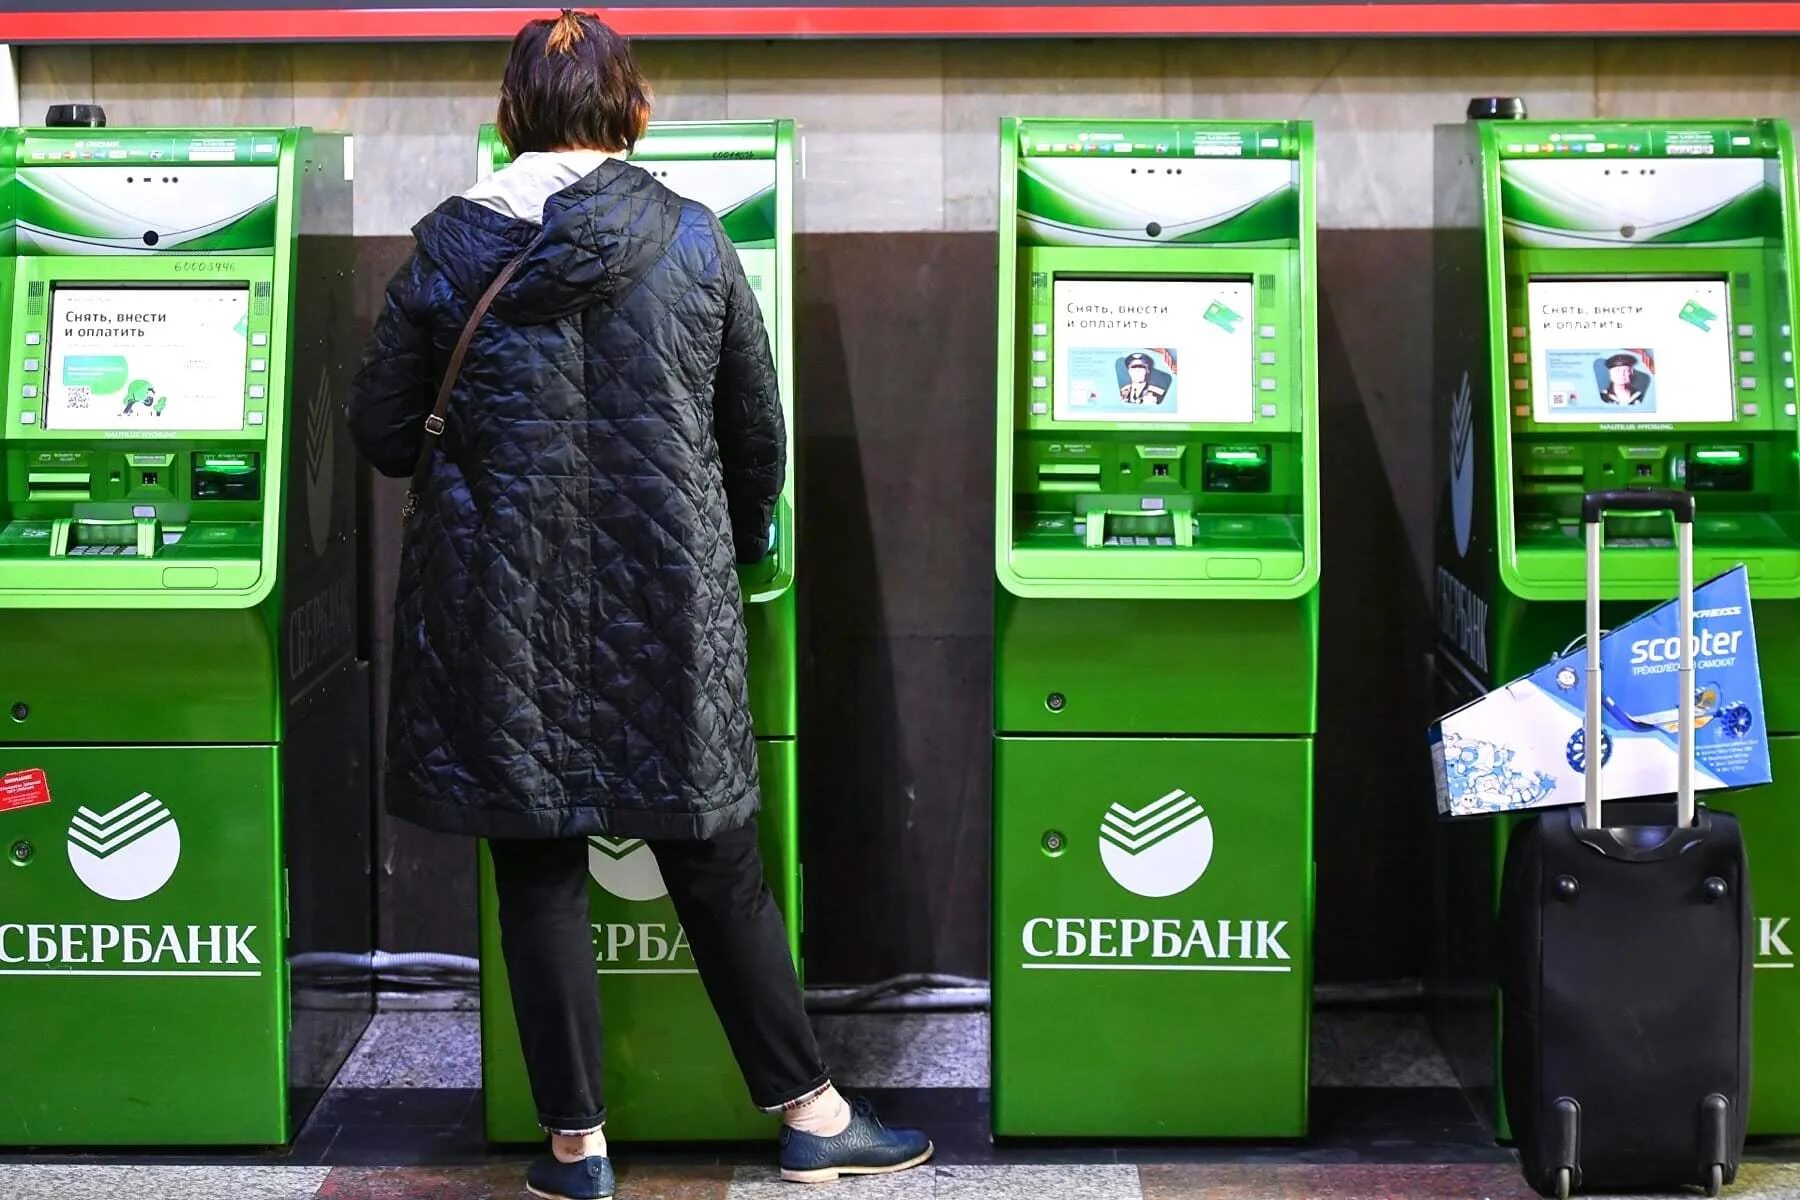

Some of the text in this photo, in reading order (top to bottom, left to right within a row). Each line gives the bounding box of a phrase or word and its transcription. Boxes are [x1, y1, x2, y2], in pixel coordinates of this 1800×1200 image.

[1067, 302, 1169, 315] Снять, внести
[1594, 305, 1643, 314] внести
[65, 311, 167, 324] Снять, внести
[1067, 319, 1148, 329] и оплатить
[1543, 320, 1624, 330] и оплатить
[65, 327, 145, 337] и оплатить
[1697, 657, 1736, 670] САМОКАТ
[0, 923, 261, 964] СБЕРБАНК
[1022, 917, 1291, 960] СБЕРБАНК
